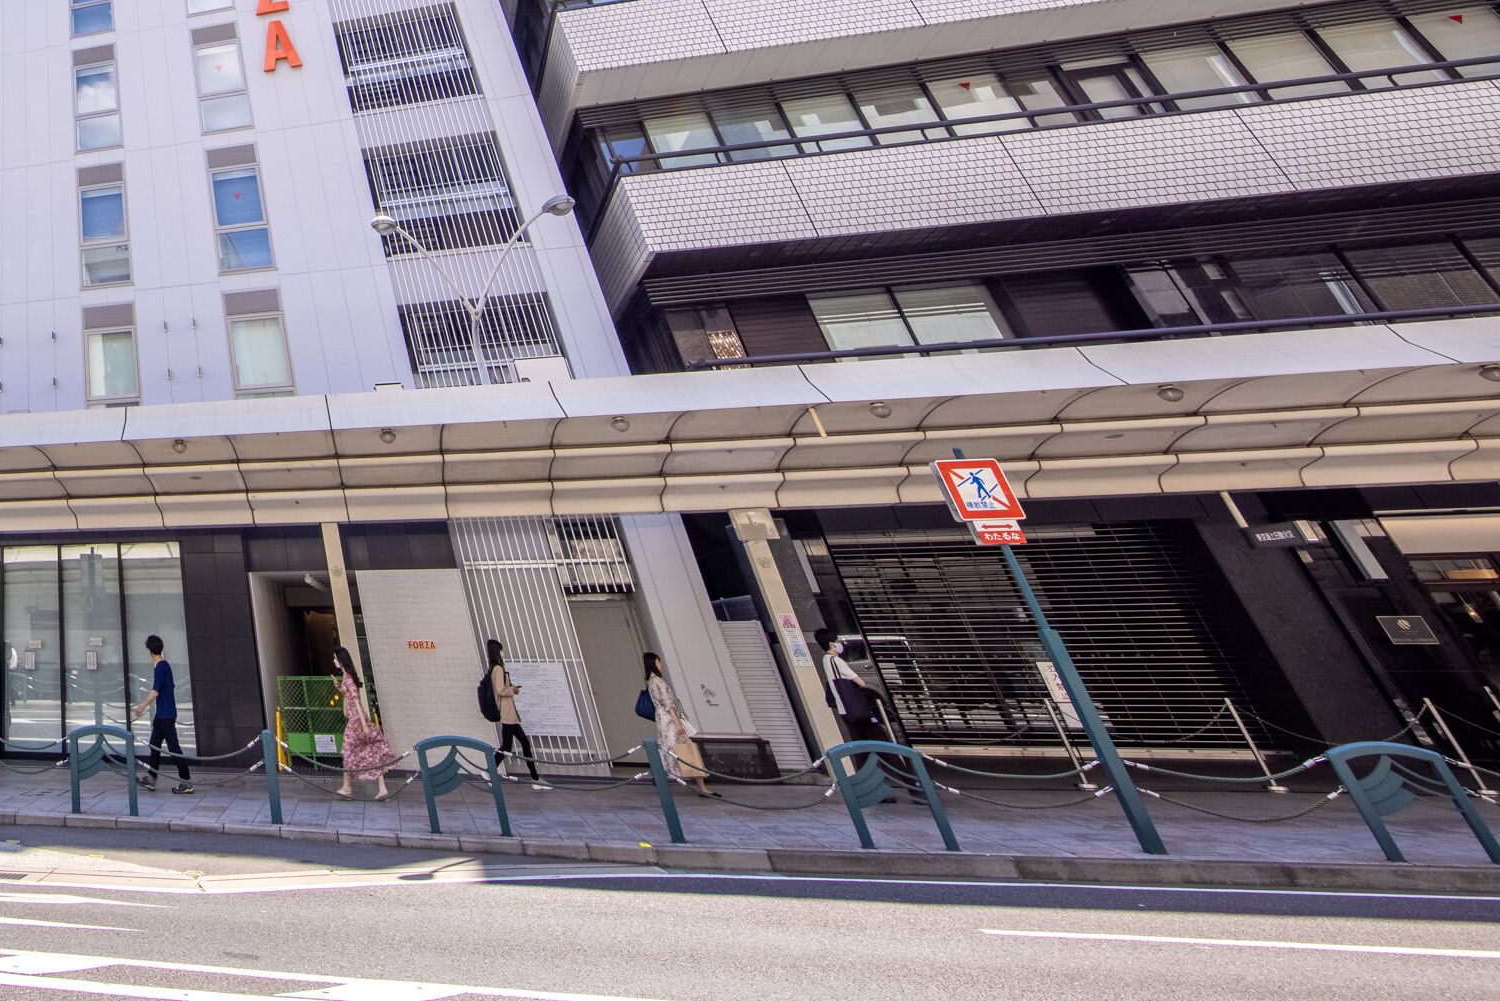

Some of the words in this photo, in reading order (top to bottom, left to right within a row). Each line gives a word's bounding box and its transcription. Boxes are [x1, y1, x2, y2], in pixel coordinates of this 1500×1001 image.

[965, 501, 995, 509] 横断禁止
[984, 532, 1021, 541] わたるな
[407, 640, 436, 650] FORZA
